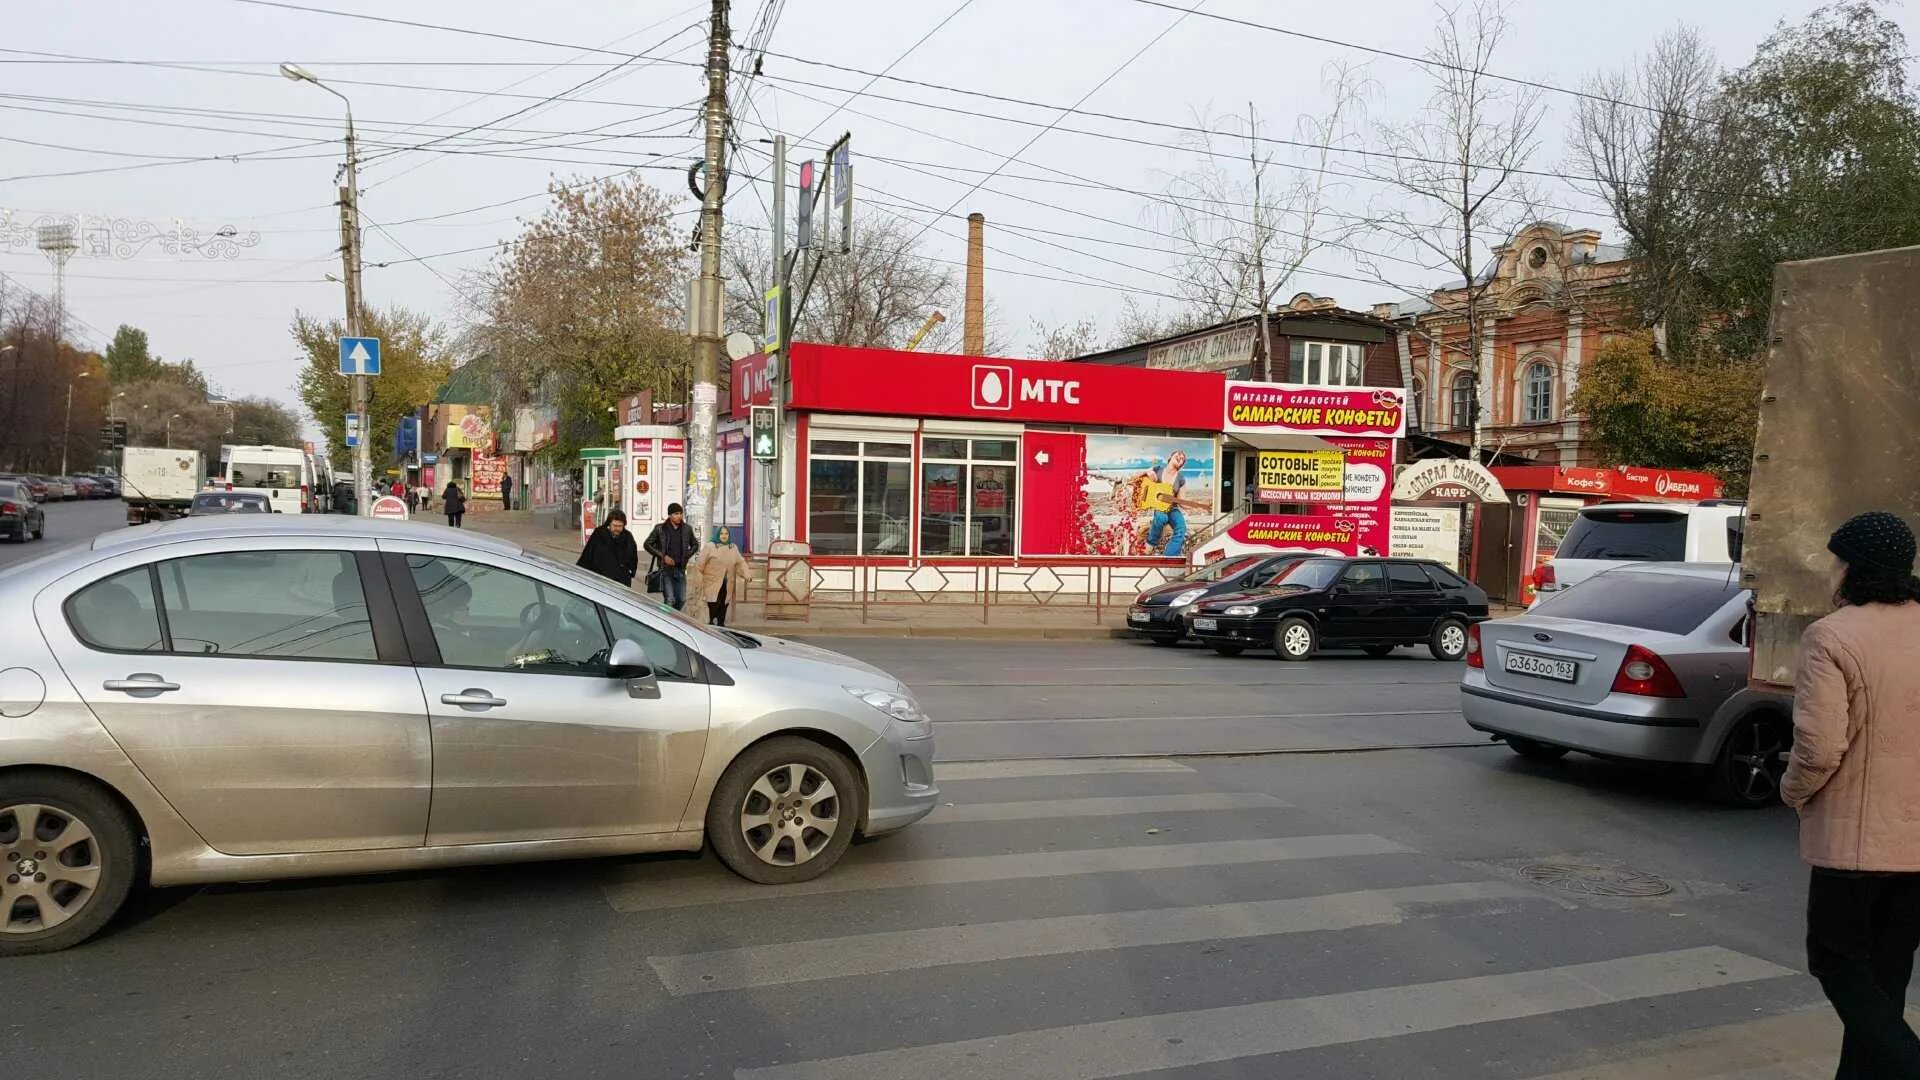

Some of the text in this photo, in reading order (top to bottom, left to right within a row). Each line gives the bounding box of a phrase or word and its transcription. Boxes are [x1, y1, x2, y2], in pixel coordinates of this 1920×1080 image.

[1020, 378, 1080, 404] МТС
[1233, 392, 1350, 406] МАГАЗИН СЛАДОСТЕЙ
[1232, 404, 1398, 427] САМАРСКИЕ КОНФЕТЫ
[1353, 449, 1386, 458] КОНФЕТЫ
[1261, 457, 1319, 471] СОТОВЫЕ
[1261, 472, 1319, 487] ТЕЛЕФОНЫ
[1410, 464, 1490, 495] СТАРАЯ САМАРА
[1567, 477, 1595, 490] Кофе
[1626, 473, 1649, 483] Бистро
[1435, 487, 1467, 497] КАФЕ
[1248, 521, 1321, 530] МАГАЗИН СЛАДОСТЕЙ
[1247, 529, 1350, 543] САМАРСКИЕ КОНФЕТЫ
[1555, 661, 1571, 674] 163
